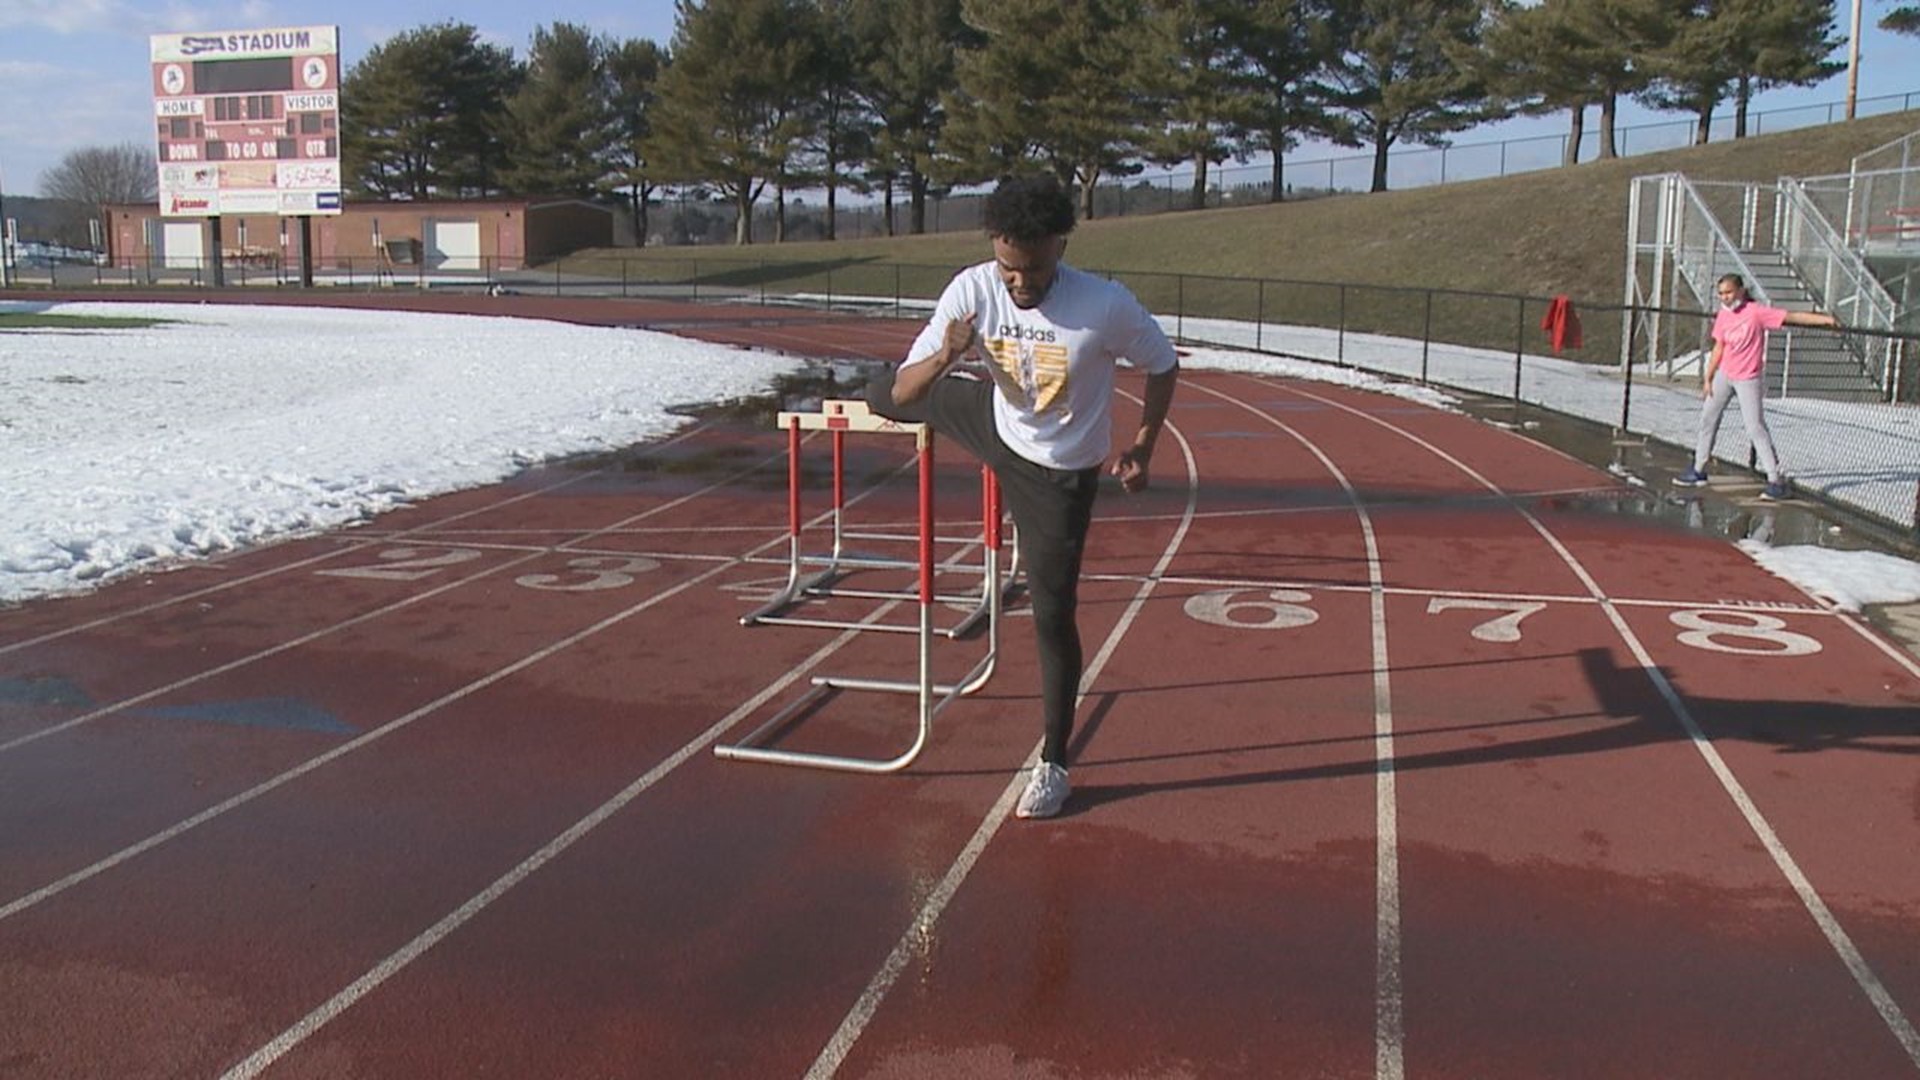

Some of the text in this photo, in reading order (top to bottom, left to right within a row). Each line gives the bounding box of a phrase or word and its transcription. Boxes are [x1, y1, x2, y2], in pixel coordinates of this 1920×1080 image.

[228, 31, 310, 51] STADIUM
[163, 102, 197, 113] HOME
[288, 95, 334, 108] VISITOR
[169, 144, 199, 160] DOWN
[225, 141, 277, 159] TO GO ON
[306, 140, 326, 157] QTR
[999, 324, 1056, 342] adidas
[313, 549, 482, 581] 2
[515, 556, 661, 591] 3
[1184, 588, 1319, 629] 6
[1426, 597, 1548, 643] 7
[1669, 609, 1823, 656] 8
